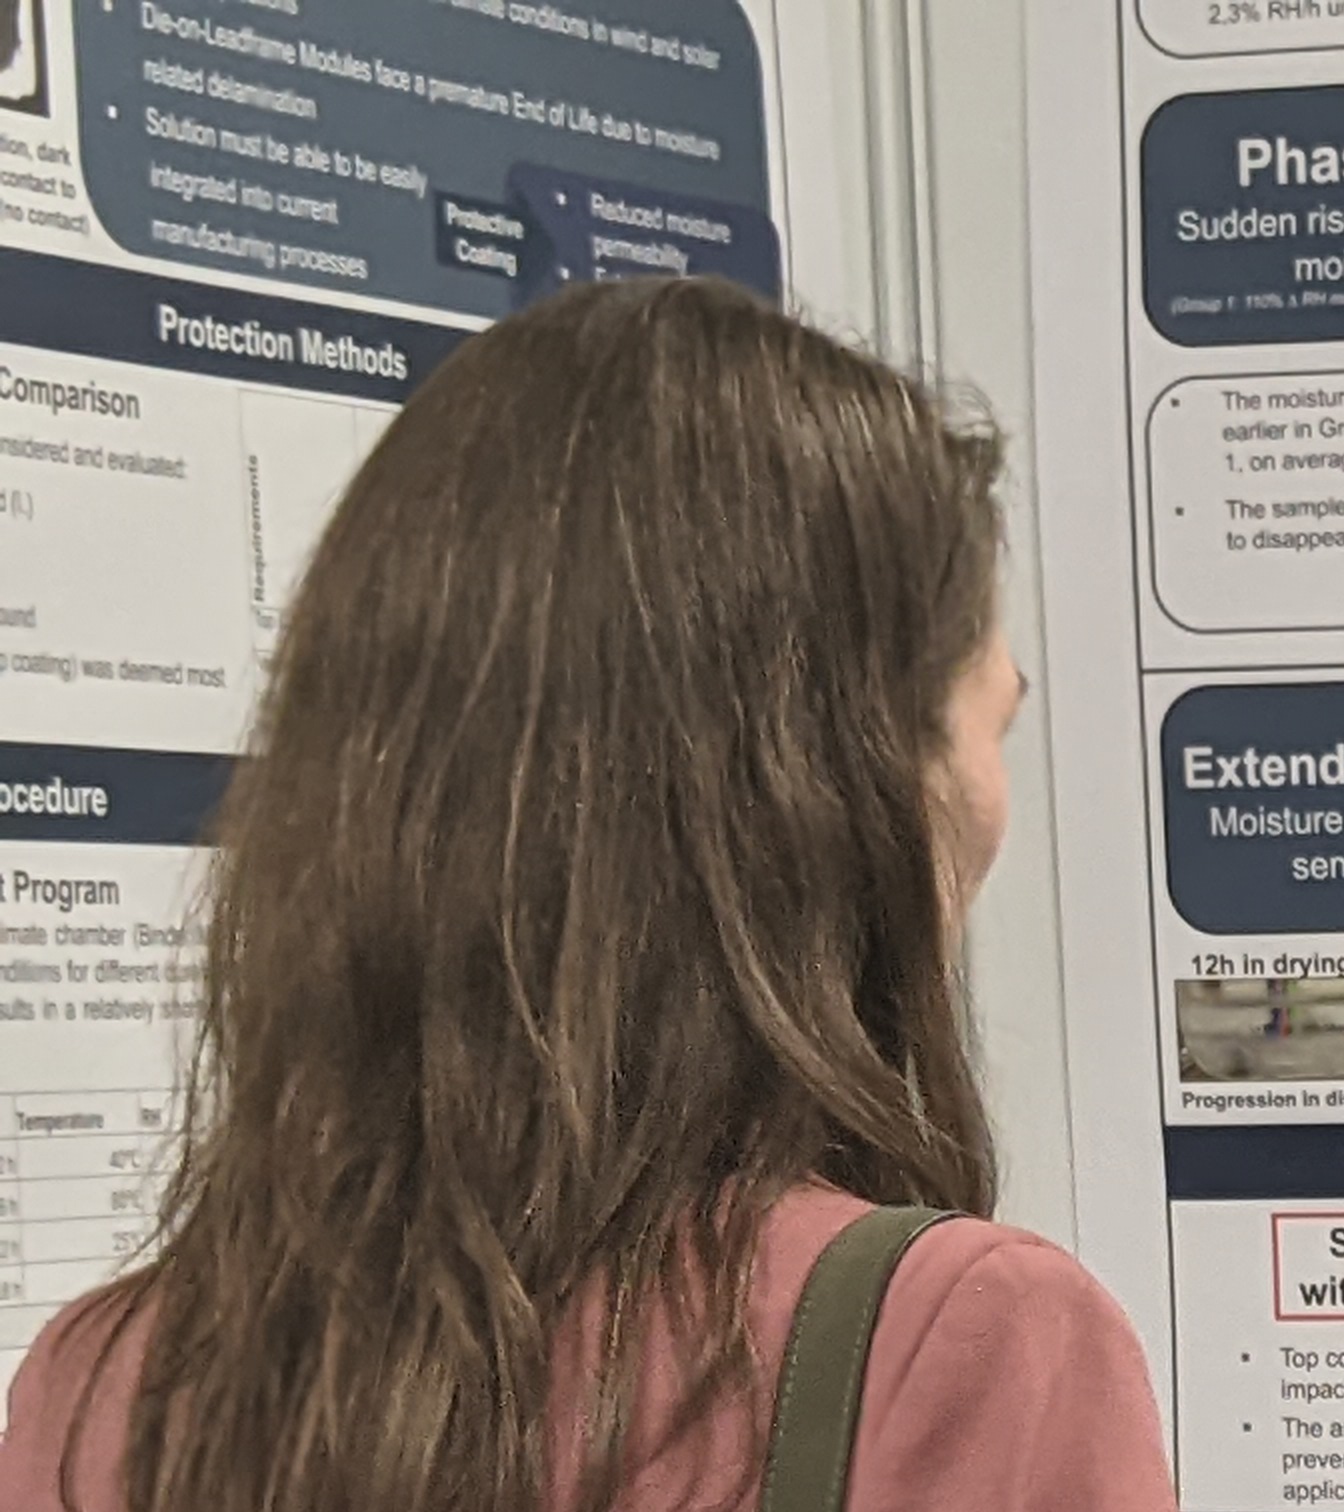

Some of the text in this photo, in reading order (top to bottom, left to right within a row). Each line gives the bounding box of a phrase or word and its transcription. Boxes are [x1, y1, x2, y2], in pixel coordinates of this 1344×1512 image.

[146, 109, 427, 198] Solution must be able to be easily
[1177, 206, 1297, 242] Sudden
[158, 305, 408, 381] Protection Methods
[0, 365, 140, 420] Comparison
[1220, 389, 1261, 412] The
[74, 446, 103, 470] and
[0, 776, 109, 818] ocedure
[1209, 804, 1343, 838] Moisture
[12, 870, 120, 912] Program
[1279, 1346, 1319, 1374] Top
